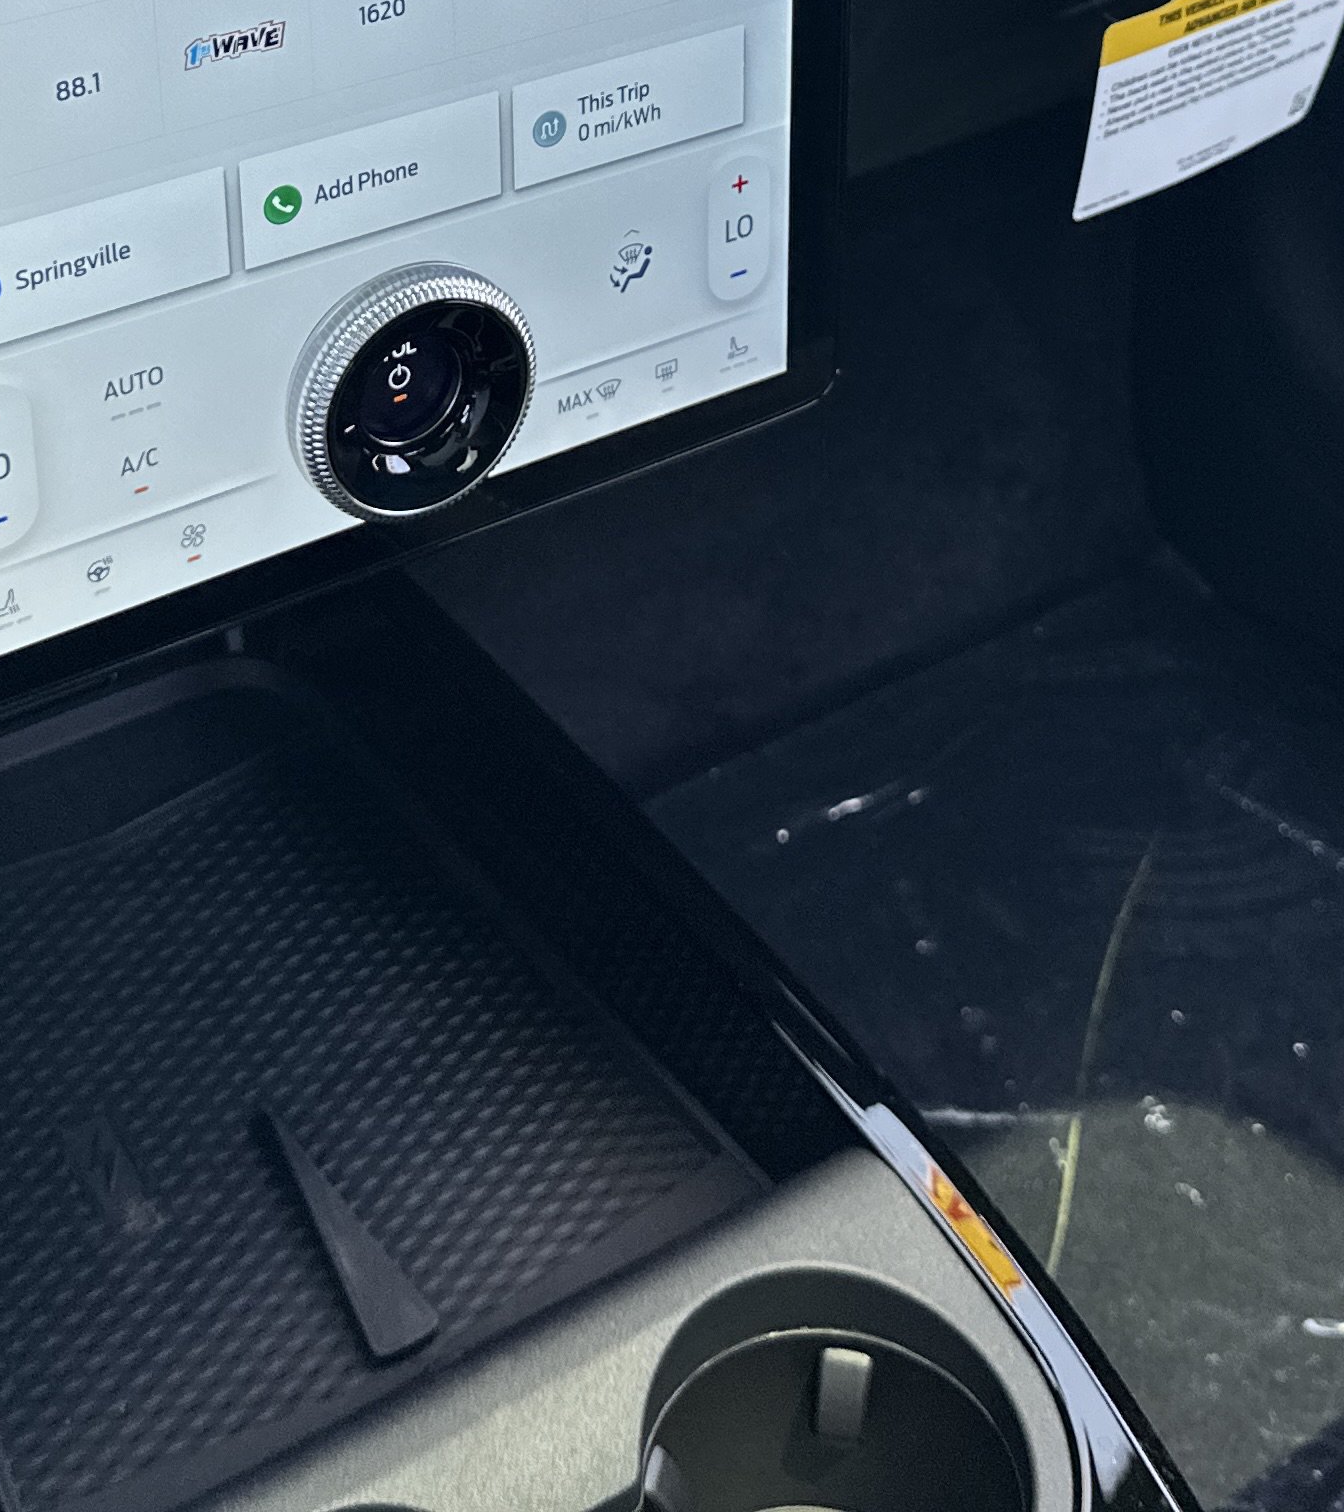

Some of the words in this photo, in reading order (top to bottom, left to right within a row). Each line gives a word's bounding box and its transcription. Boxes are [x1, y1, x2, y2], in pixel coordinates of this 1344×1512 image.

[56, 73, 101, 102] 88.1
[578, 92, 614, 116] This
[616, 81, 650, 105] Trip
[578, 123, 590, 142] 0
[594, 103, 662, 139] mi/kWh
[314, 174, 354, 205] Add
[358, 161, 419, 192] Phone
[725, 214, 754, 244] LO
[15, 242, 131, 291] Springville
[104, 365, 164, 402] AUTO
[557, 389, 593, 415] MAX
[120, 447, 160, 477] A/C
